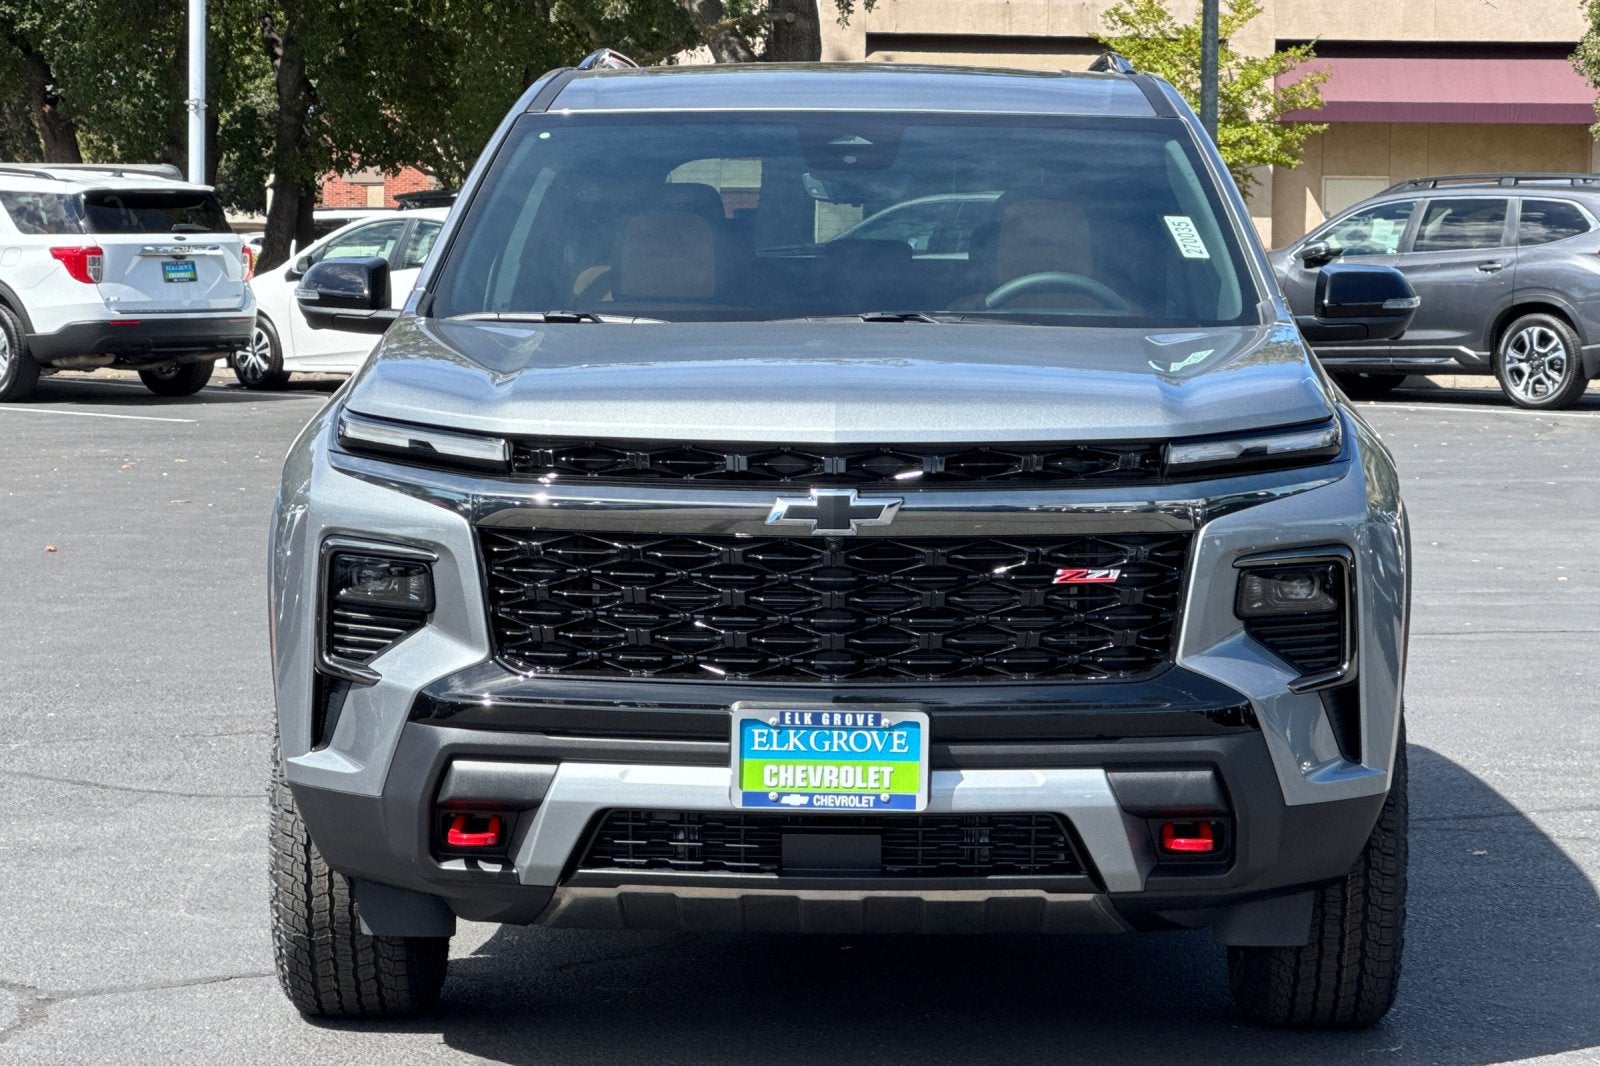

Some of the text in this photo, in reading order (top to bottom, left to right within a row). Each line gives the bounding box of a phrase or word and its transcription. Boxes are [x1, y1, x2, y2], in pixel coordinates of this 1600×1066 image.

[1171, 221, 1204, 255] 270035
[1052, 569, 1121, 584] Z71
[785, 712, 875, 726] ELK GROVE
[763, 764, 894, 790] CHEVROLET
[813, 794, 876, 808] CHEVROLET
